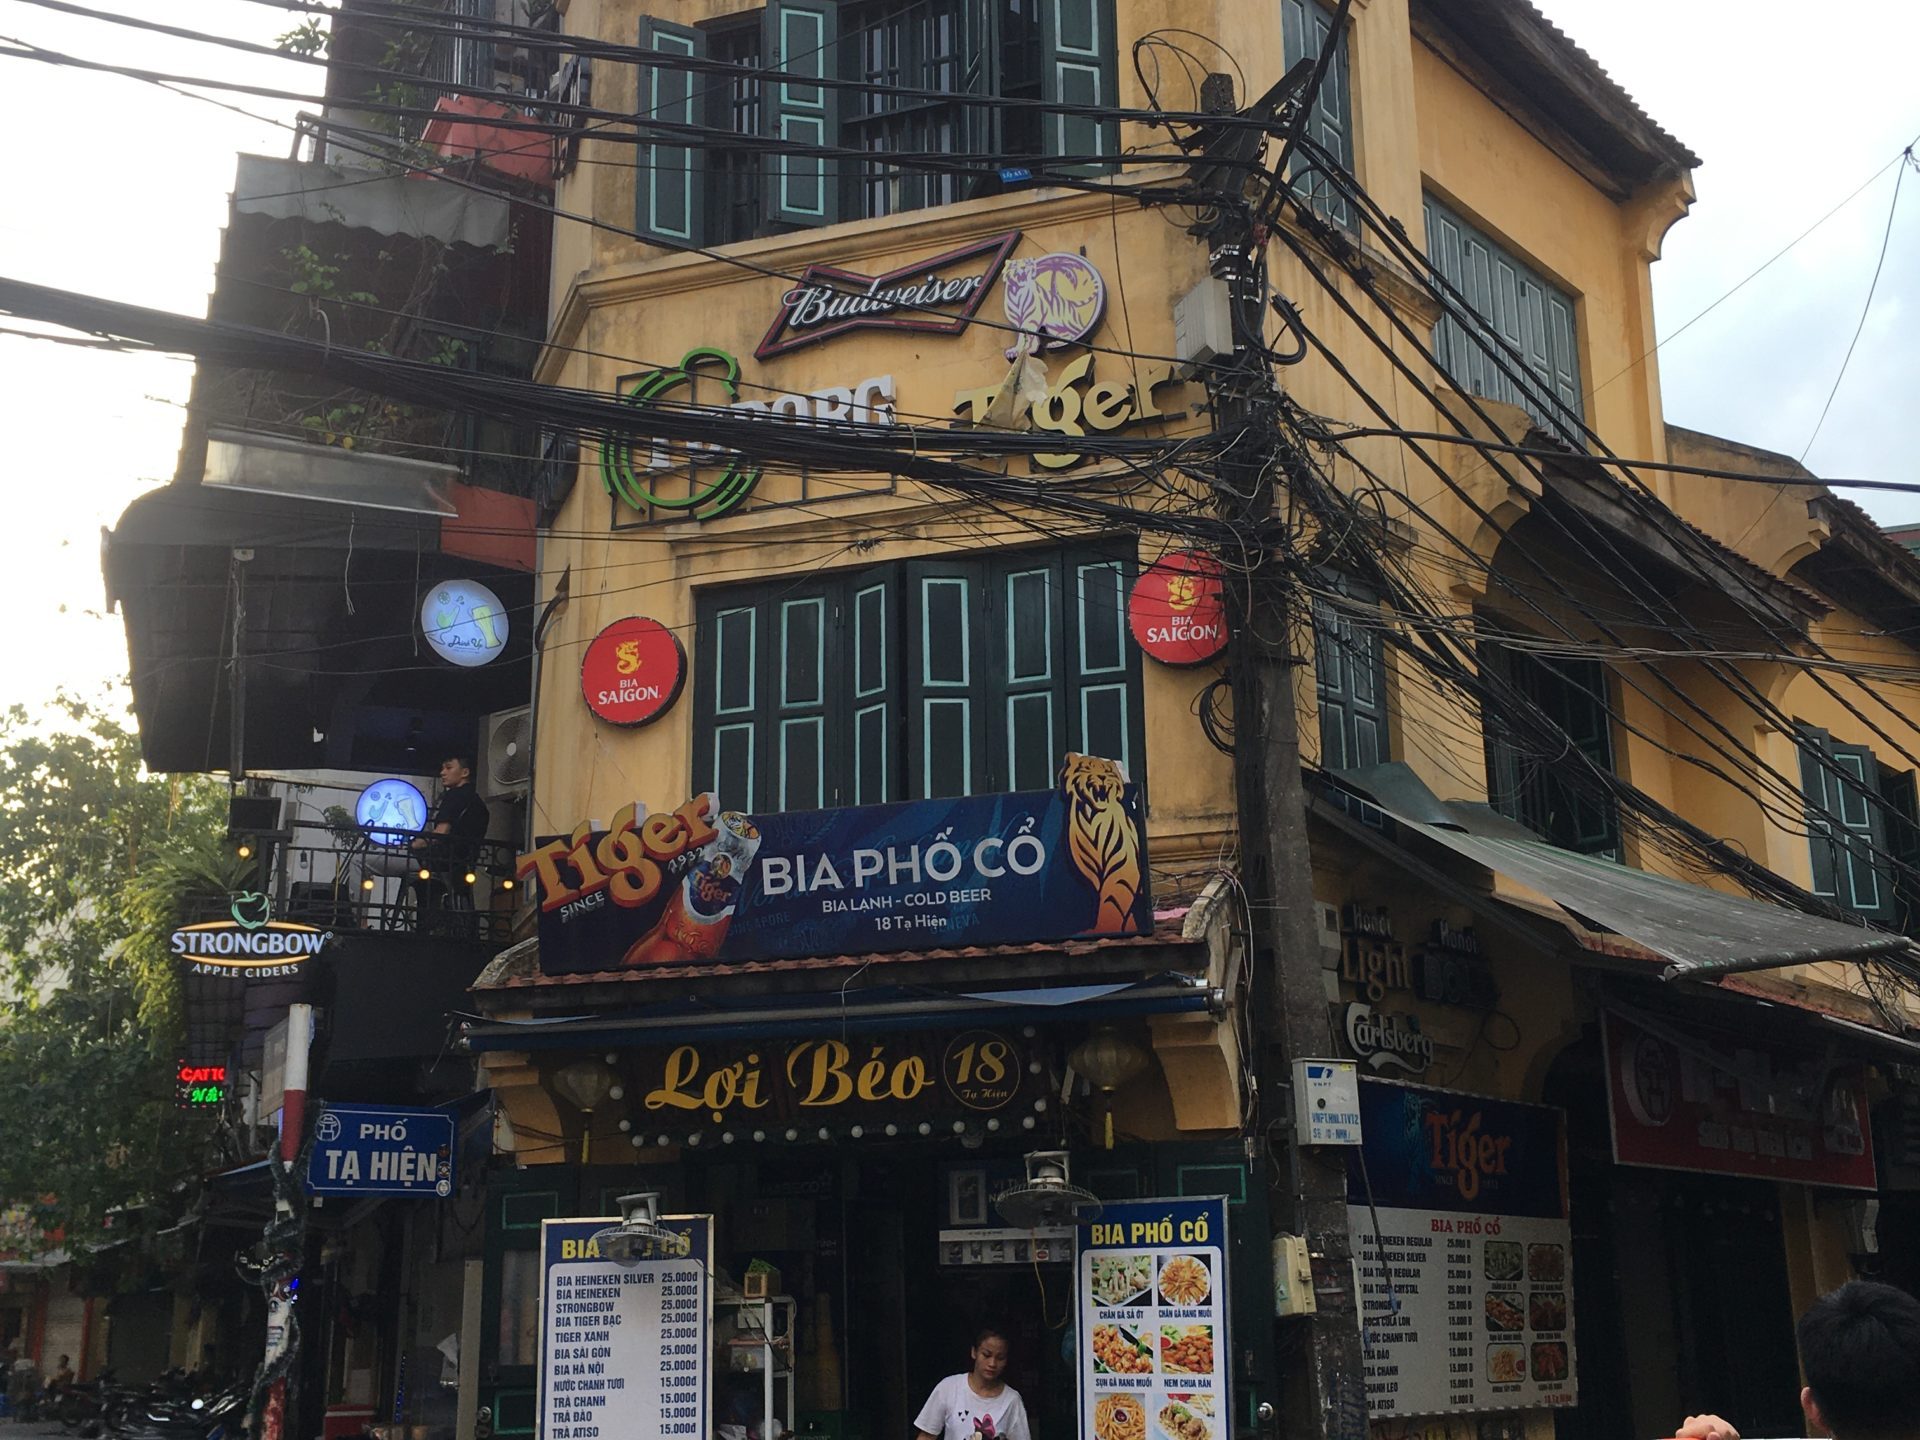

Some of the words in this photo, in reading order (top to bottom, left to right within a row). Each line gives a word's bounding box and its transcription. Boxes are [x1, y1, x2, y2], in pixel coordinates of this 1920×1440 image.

[783, 274, 983, 327] Budweiser
[952, 353, 1176, 468] Tger
[1171, 616, 1194, 626] BIA
[1146, 624, 1218, 643] SAIGON
[619, 679, 639, 689] BIA
[597, 685, 660, 705] SAIGON
[516, 792, 719, 912] Tiger
[762, 851, 844, 895] BIA
[853, 826, 963, 888] PHỐ
[973, 816, 1045, 879] CỔ
[560, 890, 605, 919] SINCE
[822, 899, 848, 913] BIA
[850, 896, 893, 913] LẠNH
[904, 893, 947, 908] COLD
[950, 888, 992, 904] BEER
[875, 916, 892, 931] 18
[894, 914, 911, 931] Tạ
[914, 914, 947, 932] Hiện
[171, 931, 326, 955] STRONGBOW
[192, 963, 239, 979] APPLE
[244, 963, 299, 979] CIDERS
[1346, 1002, 1434, 1066] Carlsberg
[953, 1040, 1008, 1086] 18
[645, 1045, 769, 1124] Lợi
[786, 1039, 936, 1107] Béo
[360, 1118, 408, 1141] PHỐ
[1424, 1109, 1513, 1201] Tiger
[326, 1149, 360, 1185] TẠ
[370, 1145, 438, 1187] HIỆN
[1092, 1223, 1125, 1245] BIA
[1131, 1213, 1174, 1244] PHỐ
[1180, 1211, 1209, 1243] CỔ
[1431, 1218, 1454, 1233] BIA
[1457, 1216, 1482, 1235] PHỐ
[1484, 1216, 1501, 1235] CỔ
[561, 1239, 600, 1259] BIA
[557, 1276, 572, 1286] BIA
[575, 1274, 621, 1286] HEINEKEN
[624, 1273, 654, 1284] SILVER
[662, 1272, 698, 1283] 25.000đ
[556, 1290, 572, 1300] BIA
[575, 1288, 621, 1299] HEINEKEN
[661, 1286, 697, 1296] 25.000đ
[556, 1302, 614, 1313] STRONGBOW
[661, 1299, 697, 1310] 25.000đ
[556, 1317, 572, 1327] BIA
[575, 1316, 600, 1326] TIGER
[603, 1315, 621, 1327] BẠC
[661, 1312, 697, 1323] 25.000đ
[555, 1332, 581, 1343] TIGER
[584, 1331, 609, 1342] XANH
[661, 1328, 697, 1339] 25.000đ
[555, 1349, 570, 1359] BIA
[573, 1347, 588, 1359] SÀI
[592, 1346, 611, 1357] GÒN
[661, 1344, 697, 1355] 25.000đ
[554, 1365, 569, 1376] BIA
[573, 1363, 584, 1375] HÀ
[588, 1362, 604, 1376] NỘI
[660, 1360, 696, 1371] 25.000đ
[578, 1379, 604, 1391] CHANH
[660, 1376, 696, 1387] 15.000đ
[1164, 1379, 1178, 1387] NEM
[1180, 1379, 1197, 1387] CHUA
[554, 1396, 571, 1408] TRÀ
[574, 1396, 606, 1407] CHANH
[660, 1392, 696, 1404] 15.000đ
[553, 1410, 570, 1423] TRÀ
[573, 1409, 592, 1422] ĐÀO
[660, 1407, 696, 1419] 15.000đ
[552, 1427, 569, 1439] TRÀ
[660, 1423, 696, 1434] 15.000đ
